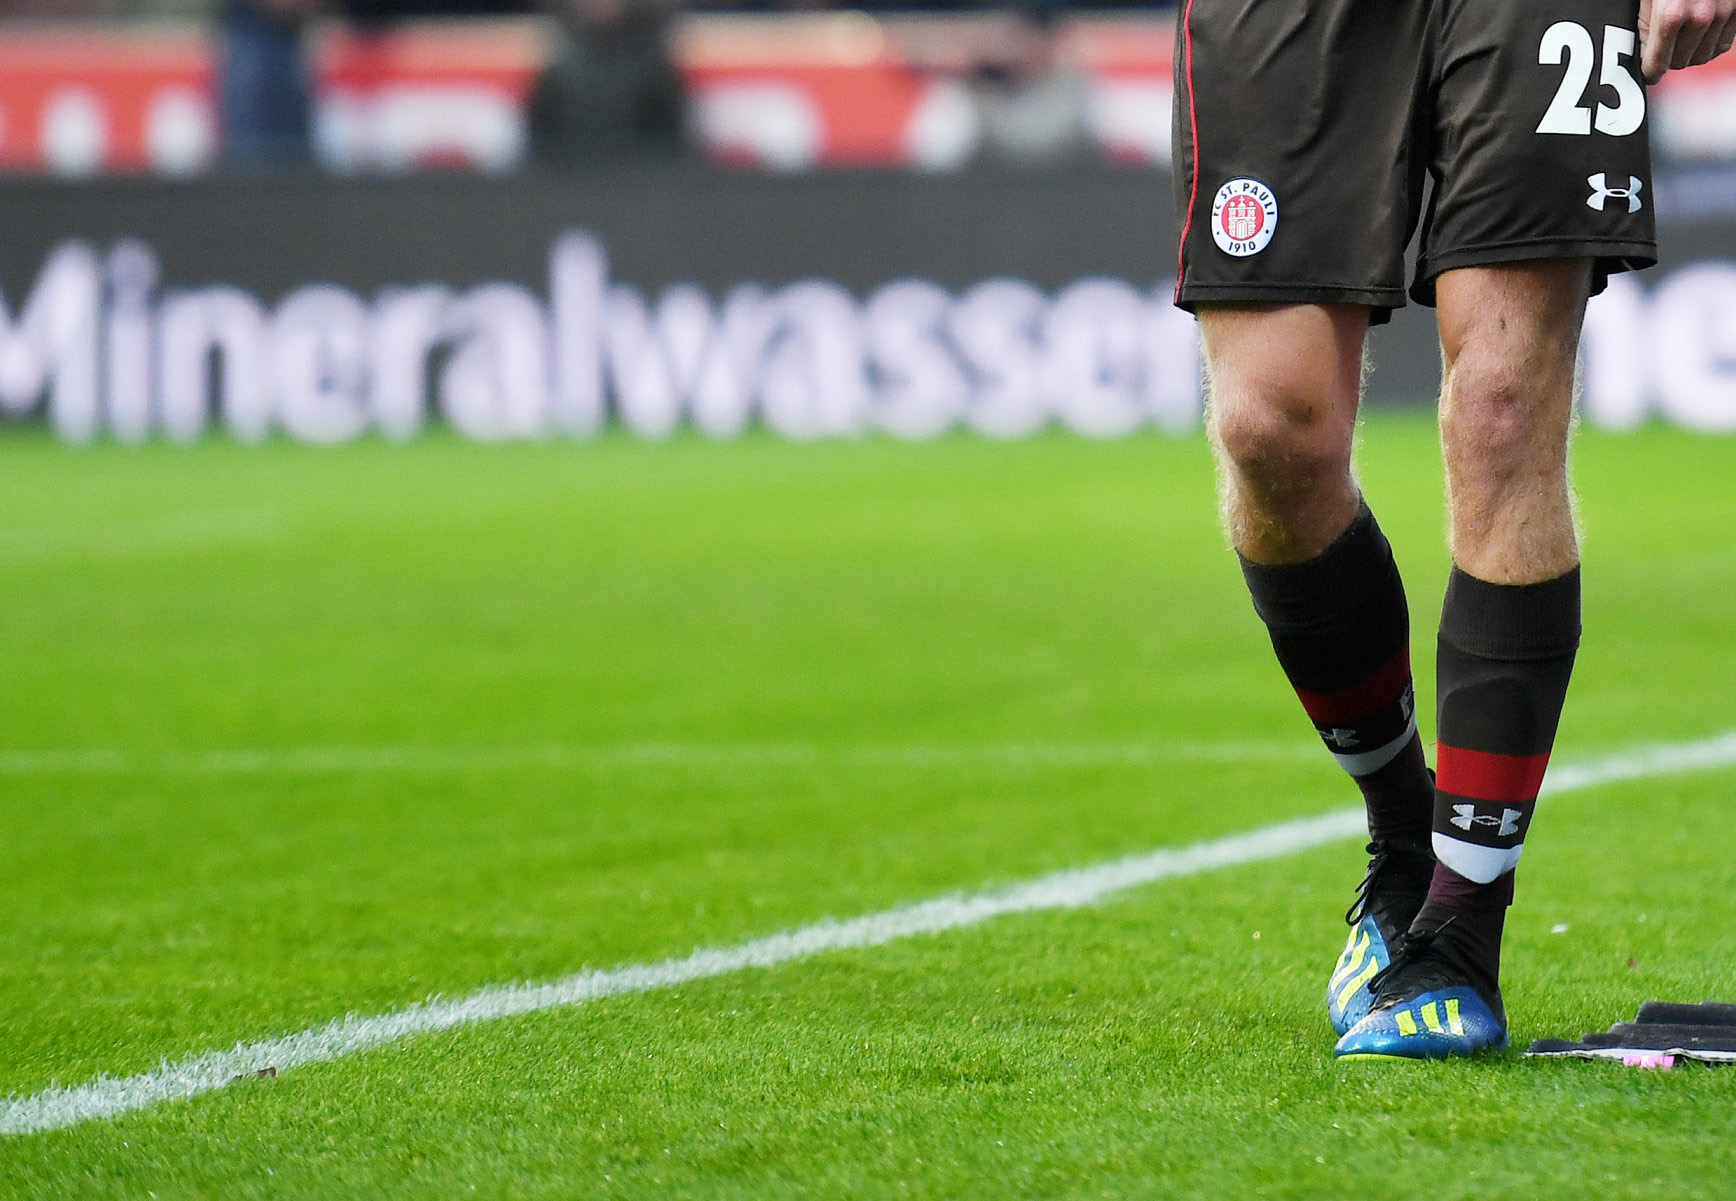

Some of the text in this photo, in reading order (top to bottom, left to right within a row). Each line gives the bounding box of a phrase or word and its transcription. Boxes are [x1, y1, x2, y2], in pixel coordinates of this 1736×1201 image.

[1535, 21, 1646, 136] 25
[1213, 183, 1275, 217] FC ST. PAULI
[1228, 241, 1256, 253] 1910
